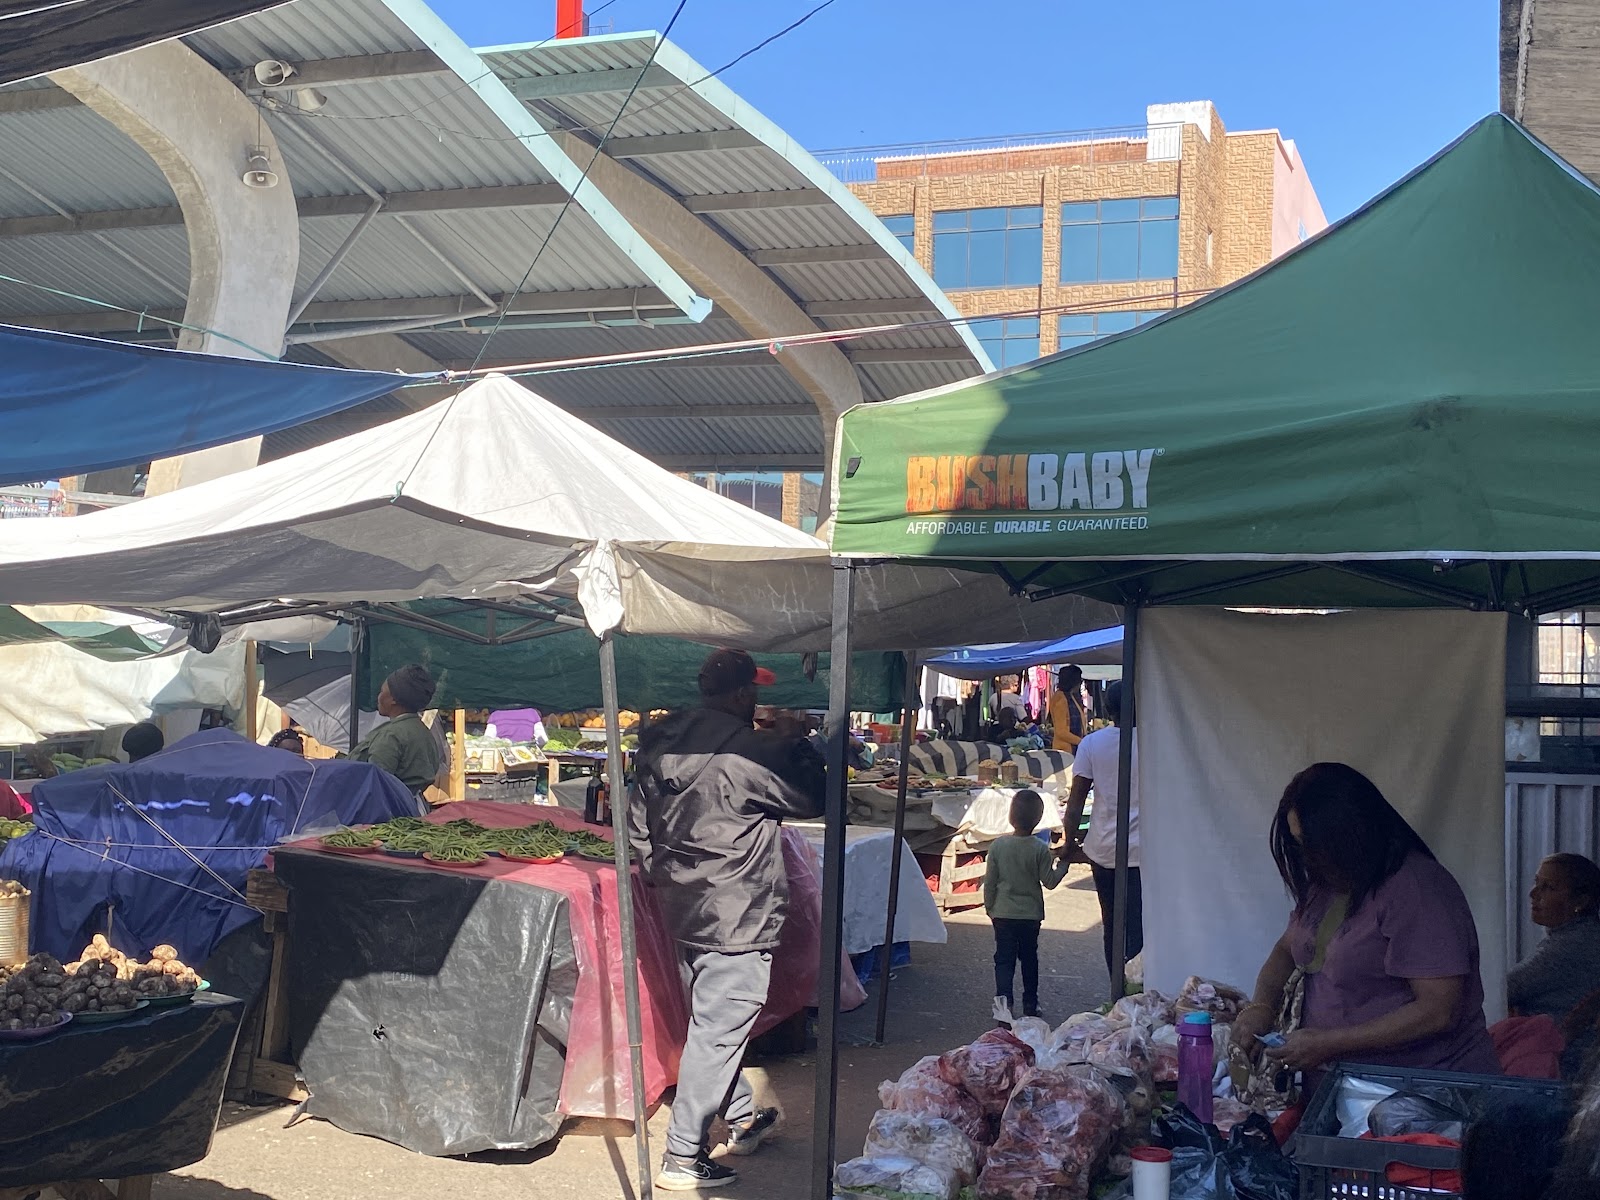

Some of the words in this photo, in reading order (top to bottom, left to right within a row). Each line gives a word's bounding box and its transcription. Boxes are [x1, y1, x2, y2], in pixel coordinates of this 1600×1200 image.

[906, 521, 990, 535] AFFORDABLE.
[994, 520, 1052, 533] DURABLE.
[1058, 516, 1149, 532] GUARANTEED.
